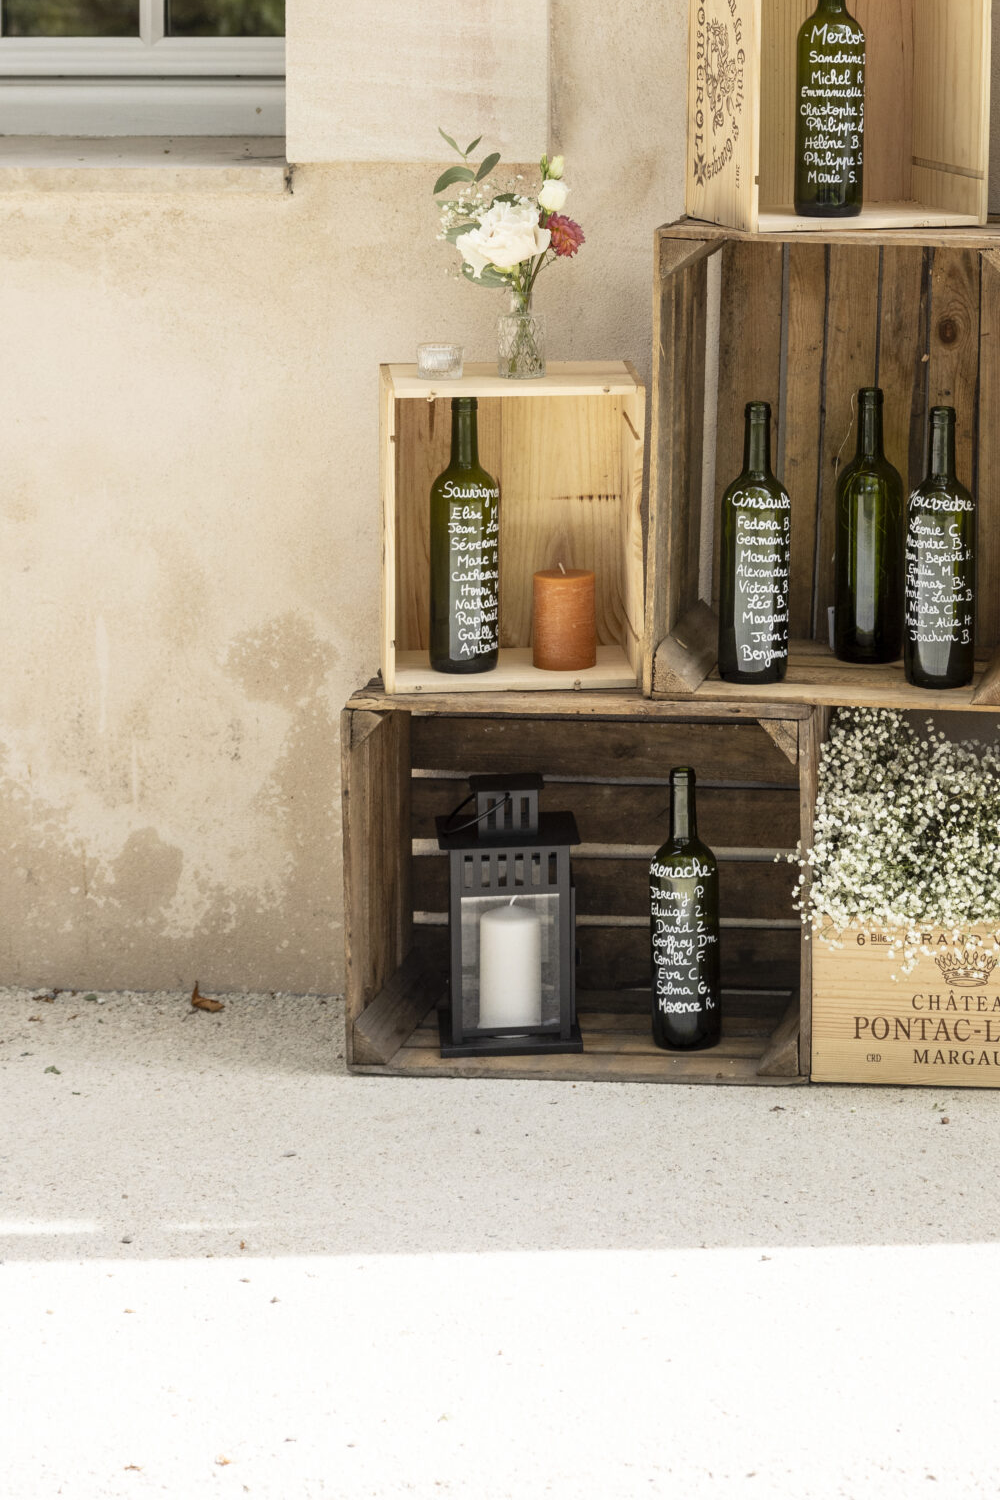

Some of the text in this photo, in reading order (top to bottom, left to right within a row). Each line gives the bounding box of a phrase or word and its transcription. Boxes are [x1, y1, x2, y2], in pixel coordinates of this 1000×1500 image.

[809, 51, 861, 64] Sandrine
[812, 69, 851, 85] Michel
[801, 86, 862, 97] Emmanuelle
[806, 117, 857, 137] Philippe
[804, 152, 855, 171] Philippe
[808, 170, 857, 183] Marie S.
[451, 506, 482, 519] Elise
[448, 523, 477, 534] Jean
[910, 517, 961, 537] Léonie C.
[952, 538, 966, 550] B.
[458, 554, 489, 569] Marc
[741, 550, 781, 562] Marion
[736, 564, 787, 577] Alexandre
[909, 564, 954, 576] Emilie M.
[907, 574, 945, 589] Thomas
[747, 594, 786, 609] Léo B.
[932, 590, 964, 603] Laure
[910, 601, 957, 614] Nicolas C.
[935, 617, 961, 627] Alice
[751, 632, 781, 642] Jean
[910, 629, 971, 644] Joachim B.
[694, 886, 704, 898] P.
[656, 920, 693, 933] David
[653, 934, 695, 955] Geoffroy
[857, 934, 865, 945] 6
[654, 950, 705, 965] Camille F.
[658, 968, 702, 980] Eva C.
[657, 980, 710, 995] Selma G.
[659, 997, 715, 1013] Maxence R.
[866, 1054, 881, 1063] CRD
